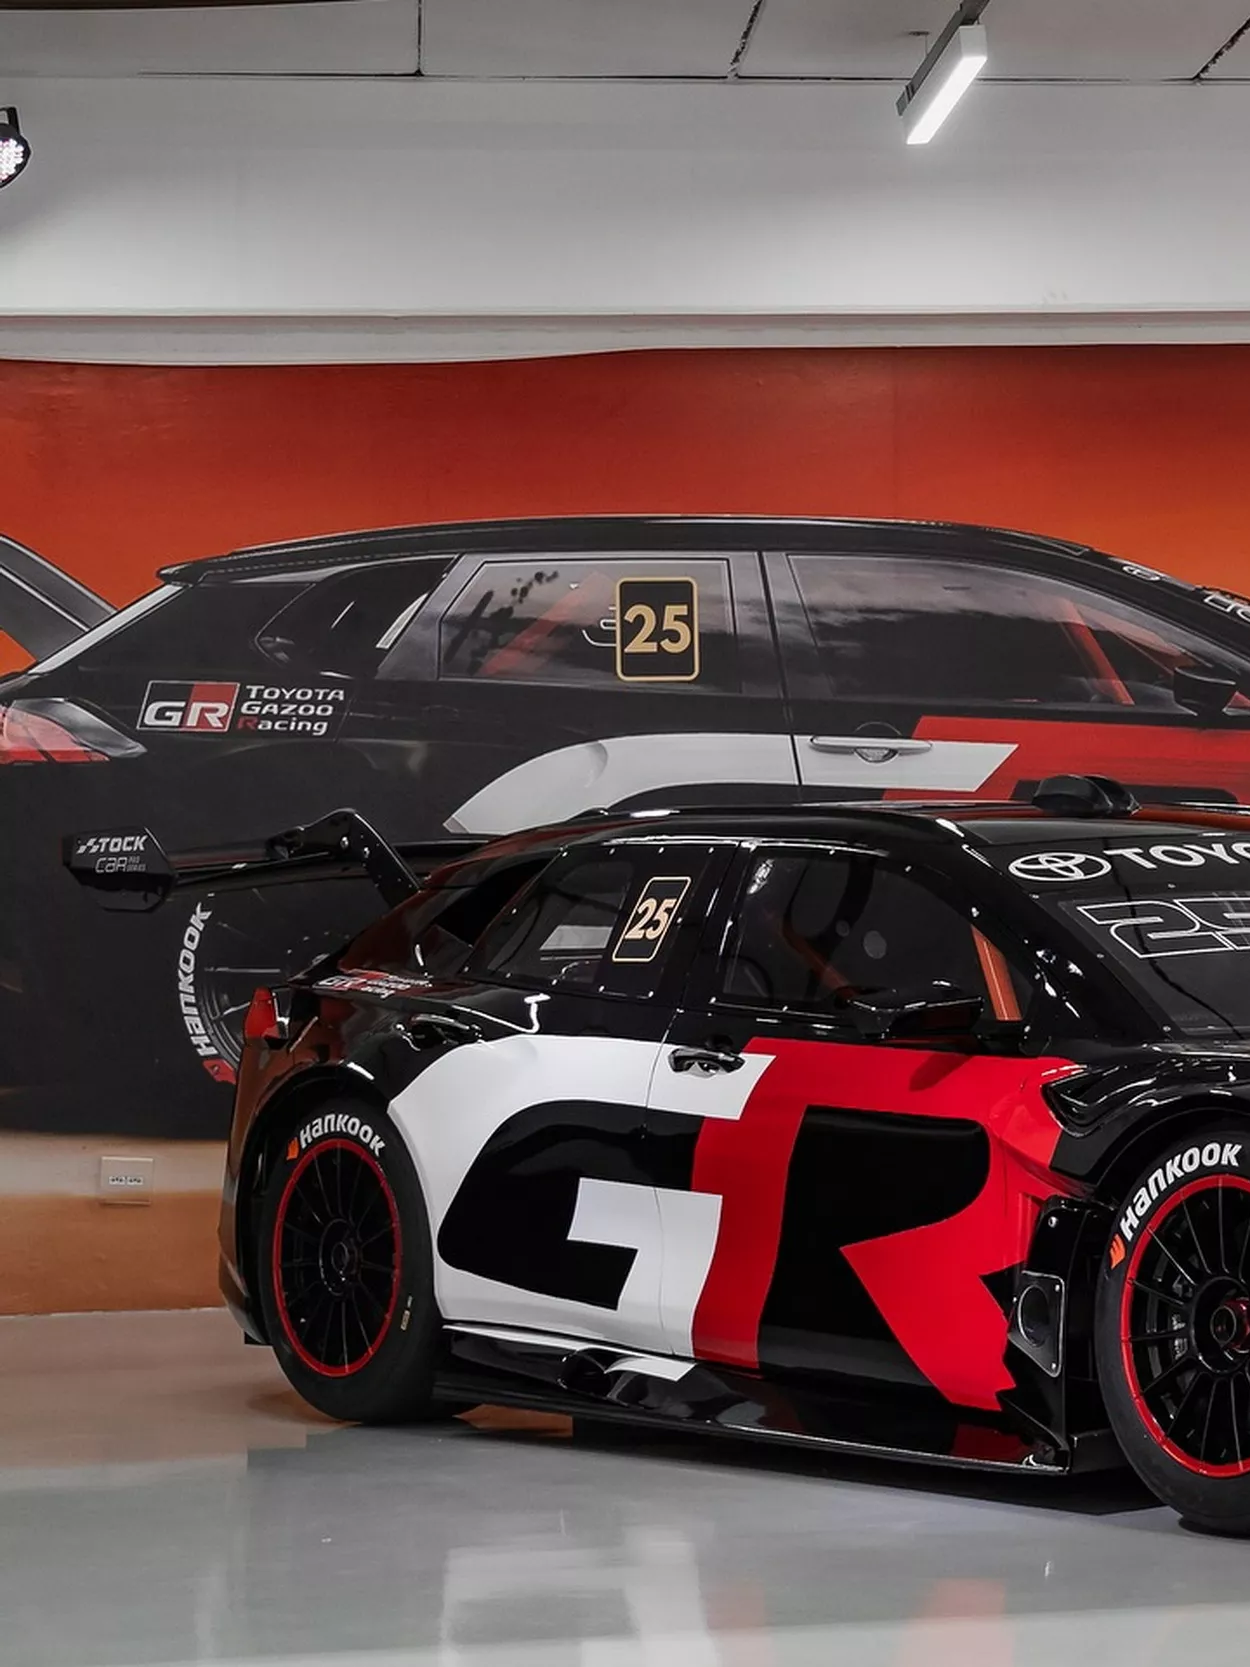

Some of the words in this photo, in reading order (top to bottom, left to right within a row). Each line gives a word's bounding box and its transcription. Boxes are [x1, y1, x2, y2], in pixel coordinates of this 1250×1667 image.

[624, 604, 692, 654] 25
[245, 685, 346, 701] TOYOTA
[142, 701, 230, 728] GR
[241, 701, 334, 716] GAZOO
[237, 716, 328, 736] Racing
[624, 898, 675, 940] 25
[389, 1035, 1082, 1412] GR
